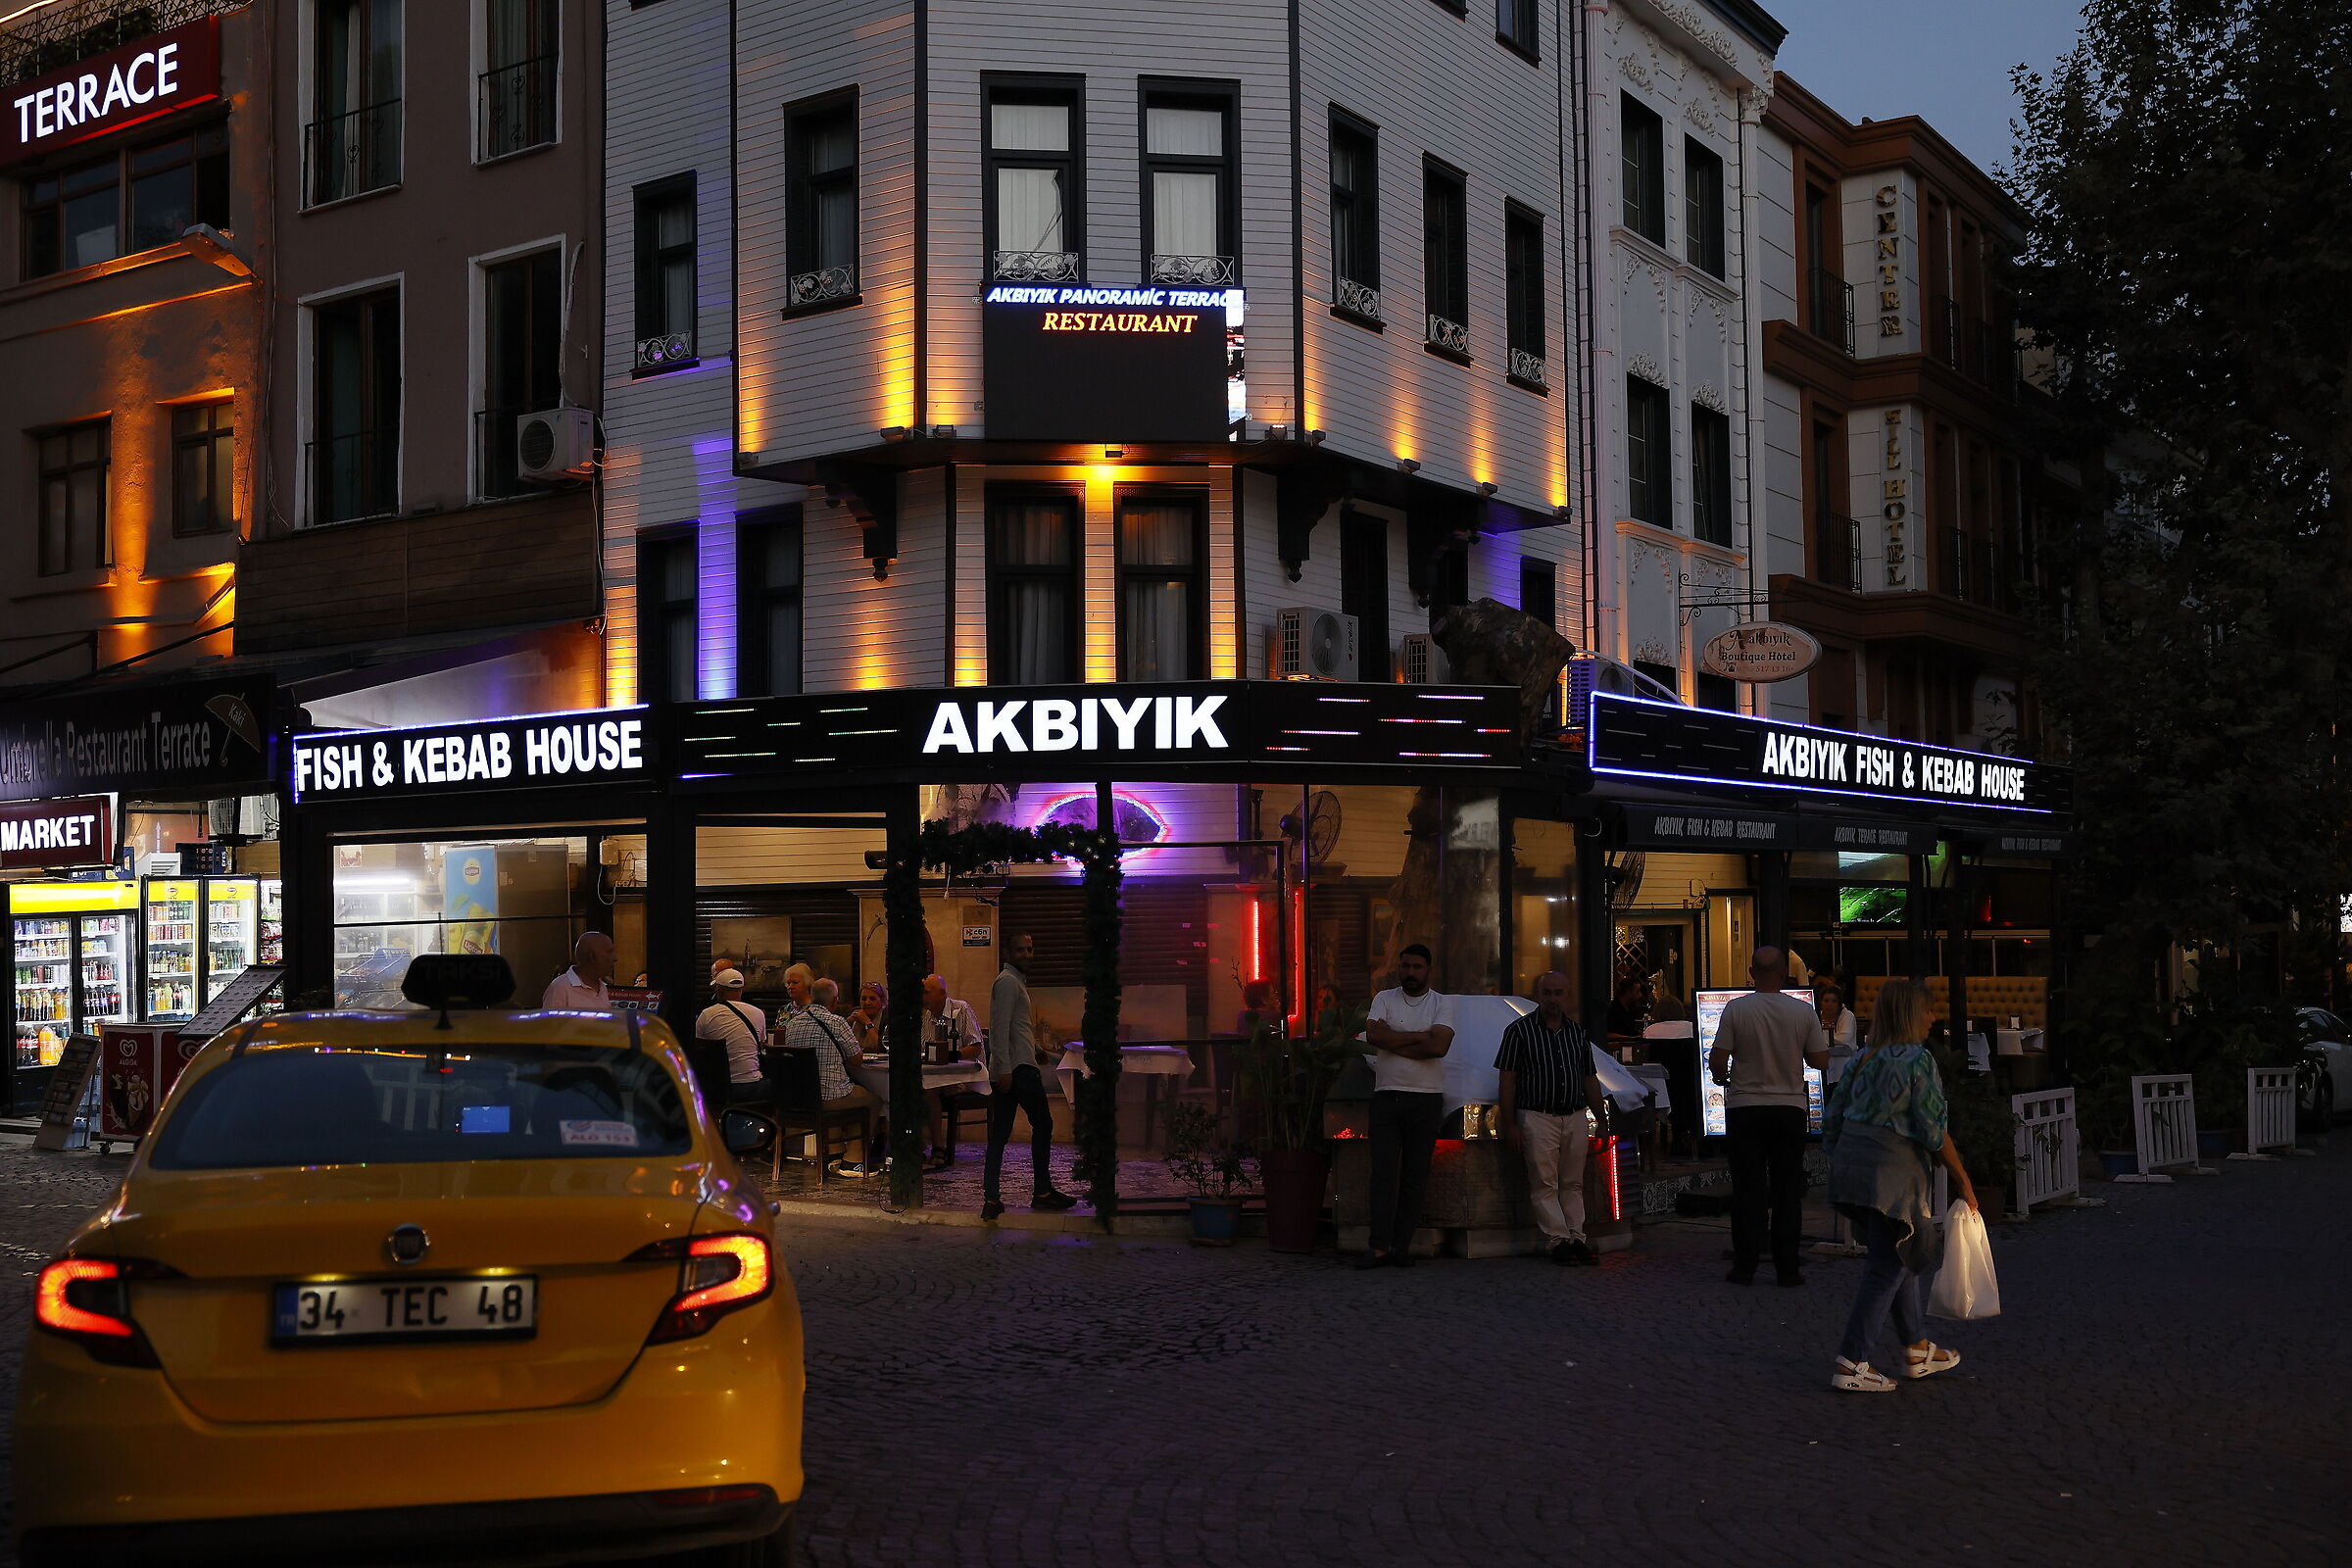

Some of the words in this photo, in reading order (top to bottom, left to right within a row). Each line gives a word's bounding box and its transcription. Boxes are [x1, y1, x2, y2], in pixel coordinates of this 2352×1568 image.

[14, 43, 178, 143] TERRACE
[1876, 184, 1903, 337] CENTER
[986, 287, 1056, 304] AKBIYIK
[1043, 312, 1198, 333] RESTAURANT
[1884, 479, 1907, 587] HOTEL
[1722, 652, 1766, 663] Boutique
[67, 720, 148, 777] Restaurant
[152, 711, 211, 771] Terrace
[922, 695, 1229, 754] AKBIYIK
[297, 743, 362, 792] FISH
[372, 741, 395, 787] &
[404, 732, 512, 785] KEBAB
[525, 720, 643, 775] HOUSE
[1762, 732, 1847, 783] AKBIYIK
[1855, 746, 1894, 788] FISH
[1901, 752, 1915, 789] &
[1922, 755, 1975, 795] KEBAB
[1981, 763, 2025, 803] HOUSE
[0, 815, 95, 852] MARKET
[1654, 816, 1685, 837] AKBIYIK
[1687, 817, 1703, 836] FISH
[1704, 819, 1710, 836] &
[1736, 821, 1777, 840] RESTAURANT
[299, 1291, 345, 1330] 34
[380, 1286, 449, 1327] TEC
[477, 1285, 523, 1324] 48
